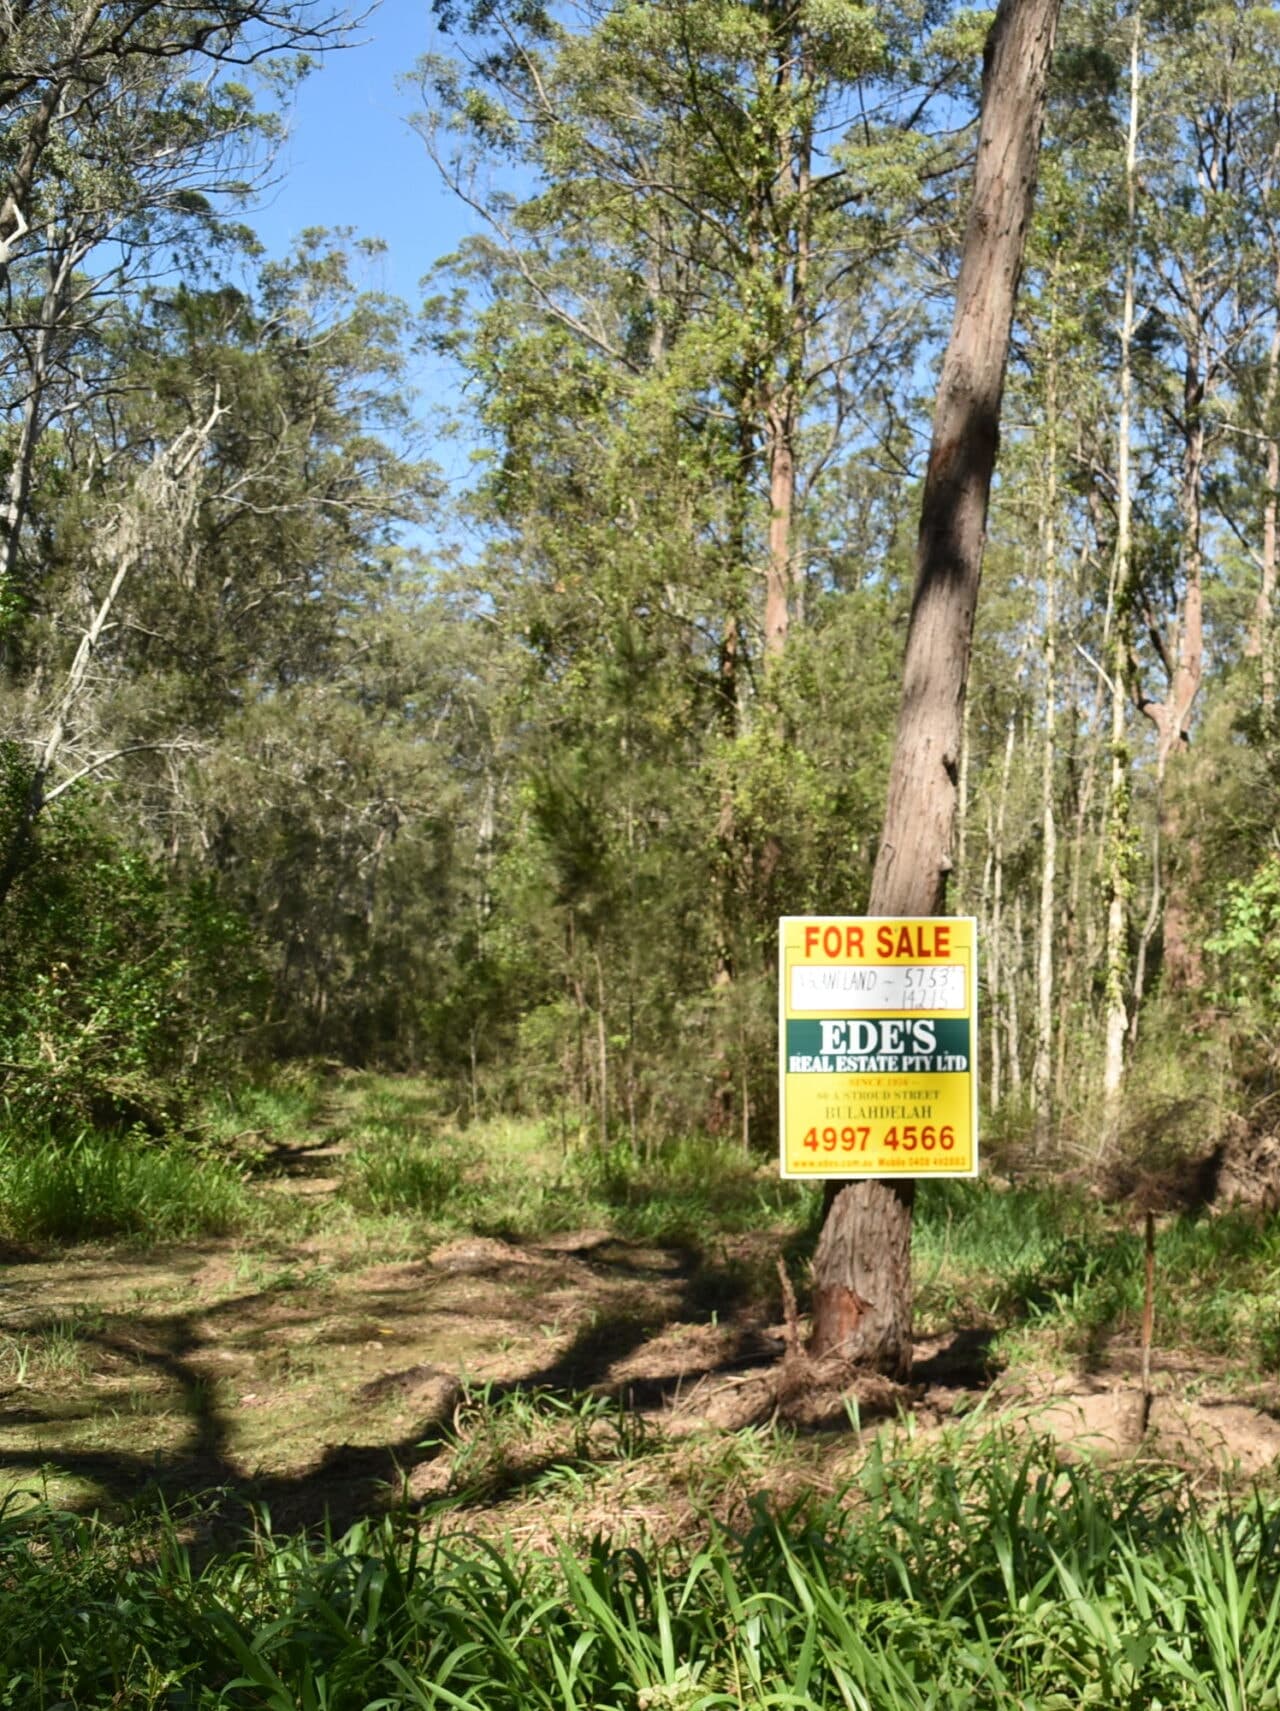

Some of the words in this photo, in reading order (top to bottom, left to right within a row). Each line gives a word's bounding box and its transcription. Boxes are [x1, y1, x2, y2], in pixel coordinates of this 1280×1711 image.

[805, 926, 865, 958] FOR
[876, 926, 951, 958] SALE
[819, 1019, 937, 1055] EDE'S
[789, 1055, 833, 1073] REAL
[835, 1055, 899, 1073] ESTATE
[902, 1055, 934, 1072] PTY
[936, 1054, 968, 1072] LTD
[894, 1089, 941, 1100] STREET
[825, 1105, 933, 1120] BULAHDELAH
[803, 1126, 872, 1151] 4997
[884, 1125, 955, 1150] 4566
